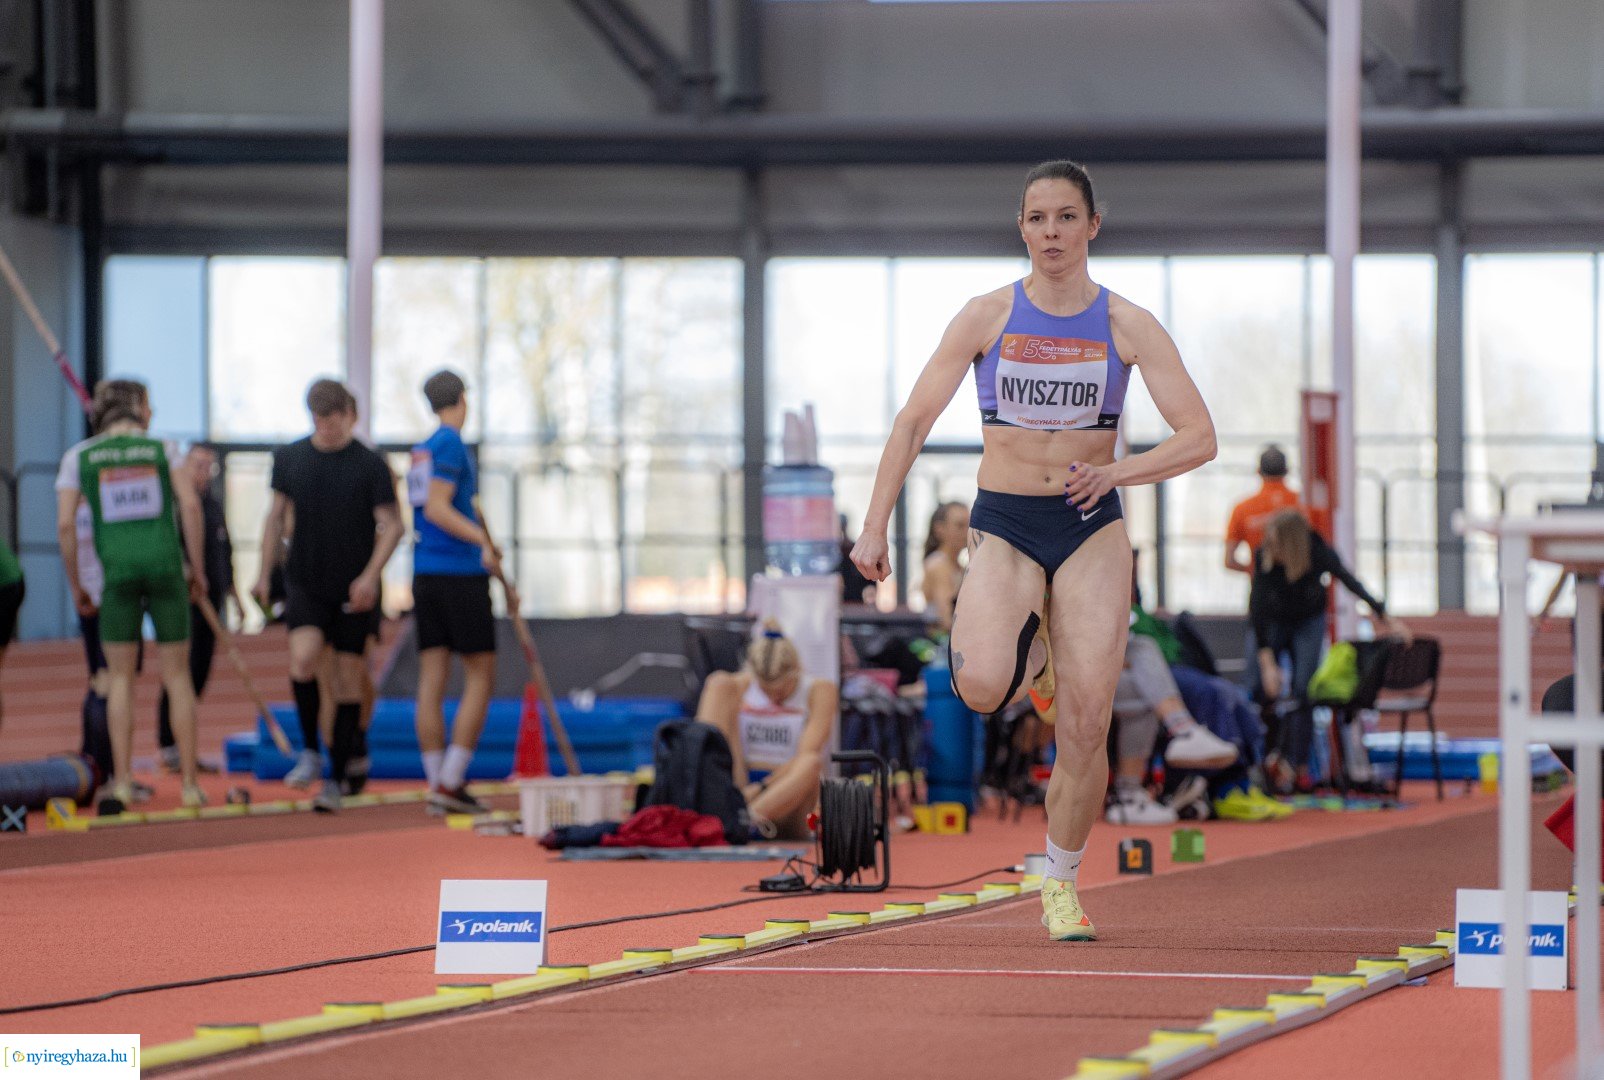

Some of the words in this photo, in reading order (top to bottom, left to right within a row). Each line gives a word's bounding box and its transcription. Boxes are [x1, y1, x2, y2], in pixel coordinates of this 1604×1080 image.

[1002, 376, 1099, 406] NYISZTOR
[469, 919, 535, 935] polanik
[1489, 932, 1556, 948] pnik
